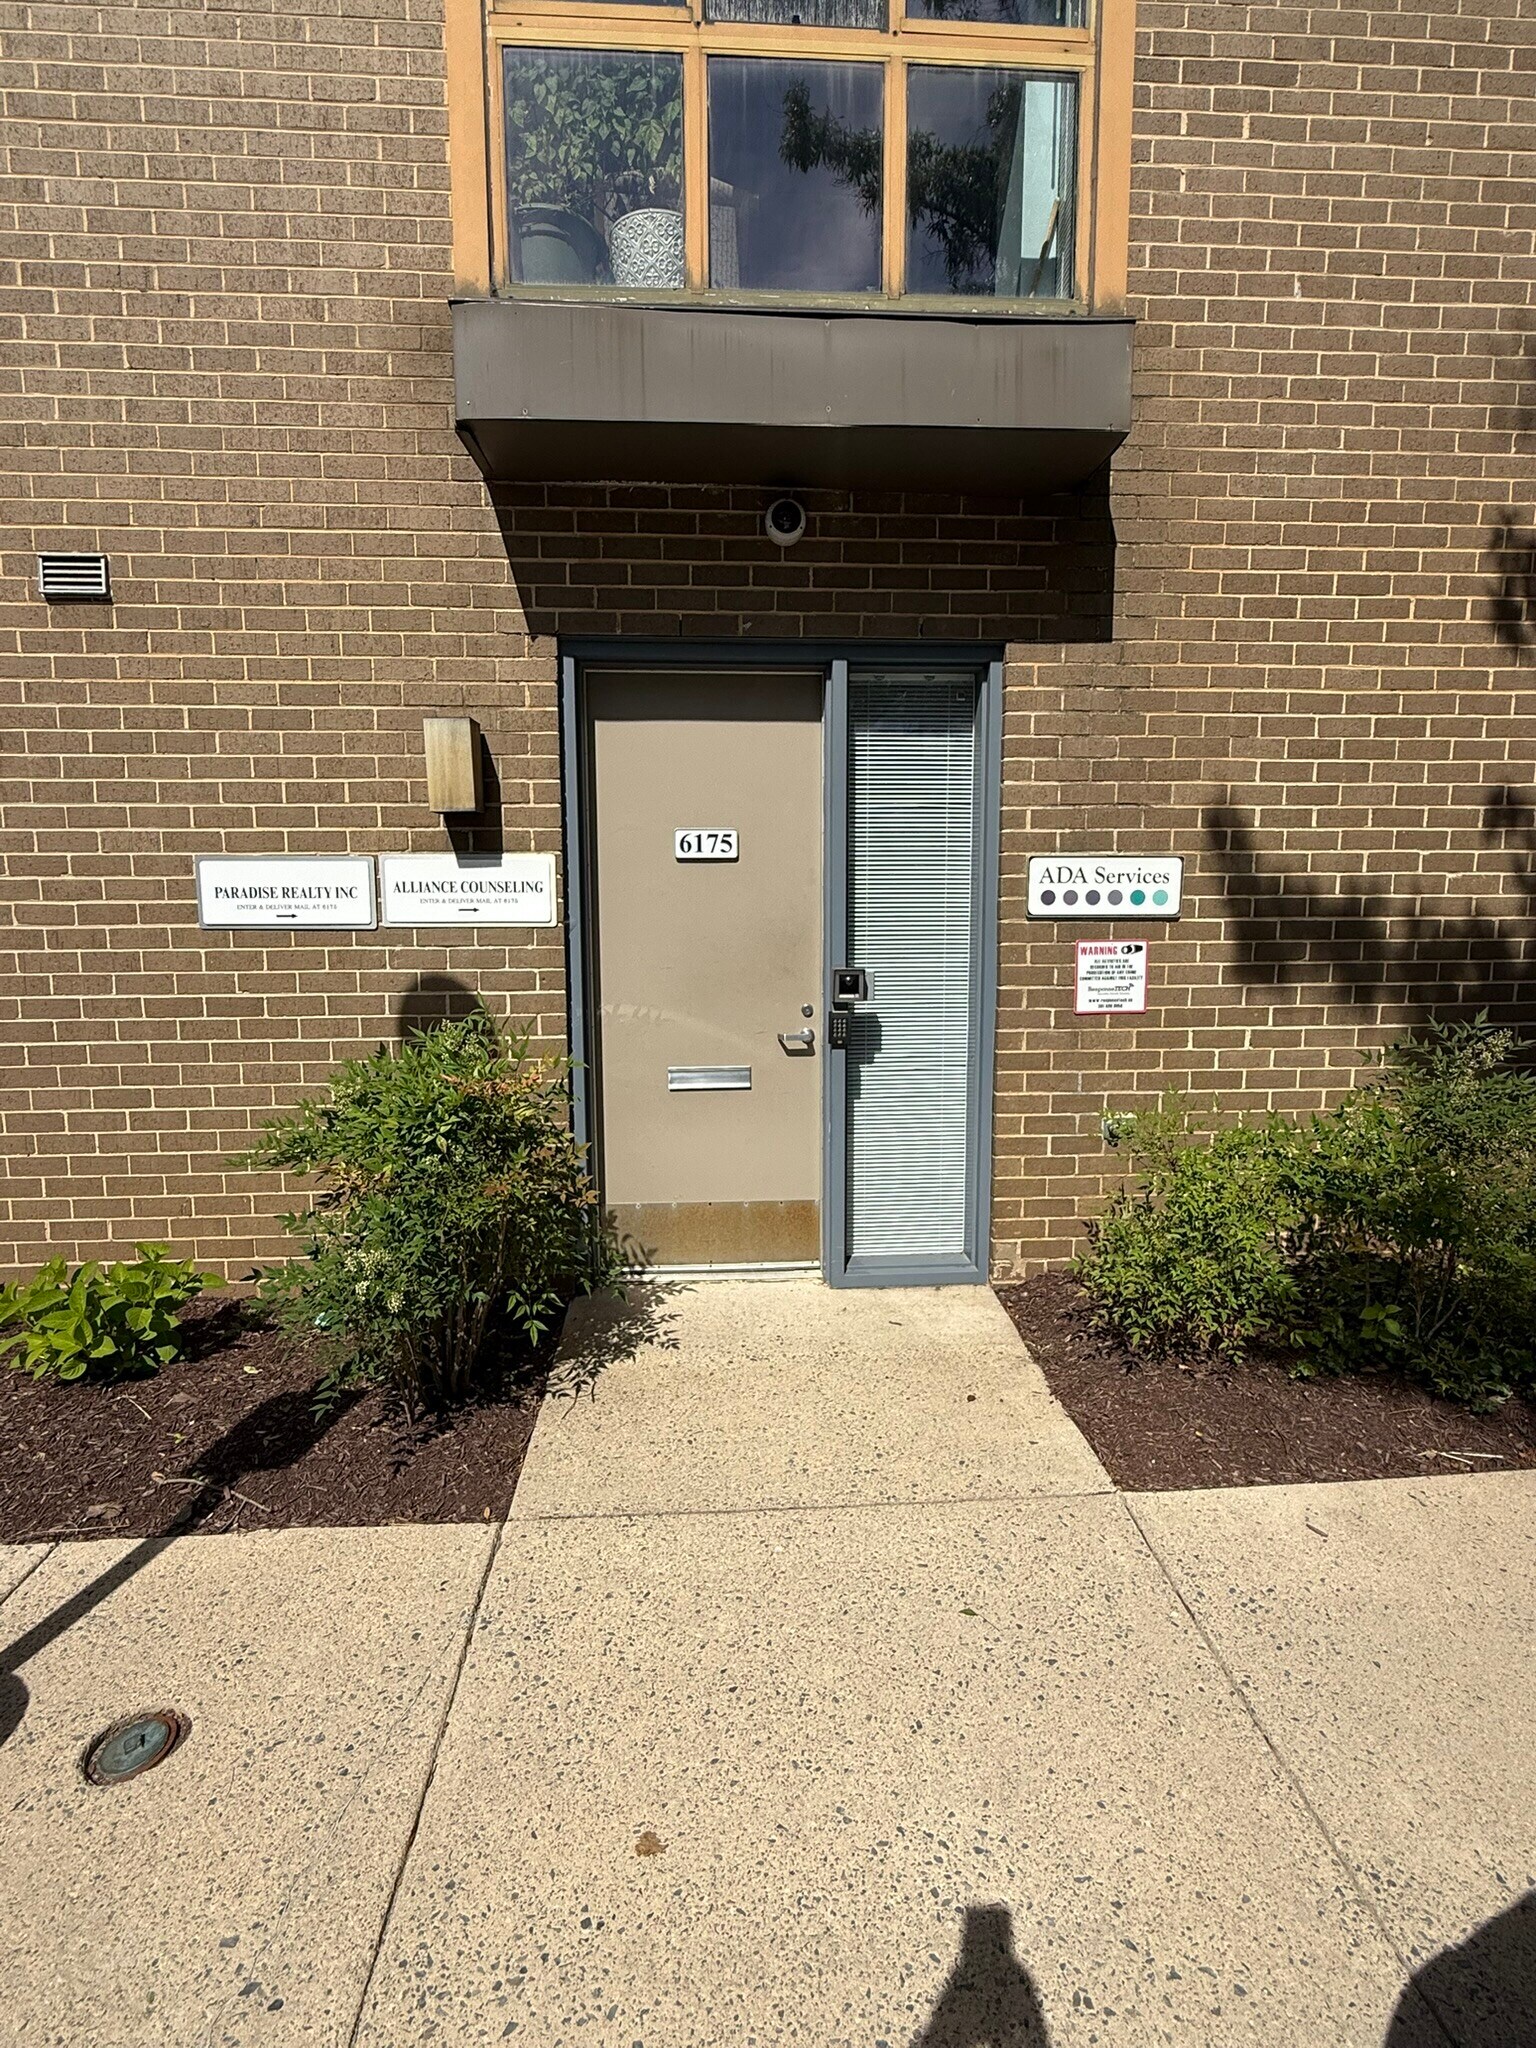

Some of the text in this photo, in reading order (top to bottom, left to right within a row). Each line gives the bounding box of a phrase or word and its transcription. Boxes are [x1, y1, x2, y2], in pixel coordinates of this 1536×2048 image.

[679, 833, 733, 853] 6175
[1039, 866, 1170, 884] ADA Services
[214, 886, 358, 899] PARADISE REALTY INC
[393, 881, 543, 893] ALLIANCE COUNSELING
[1080, 946, 1118, 956] WARNING
